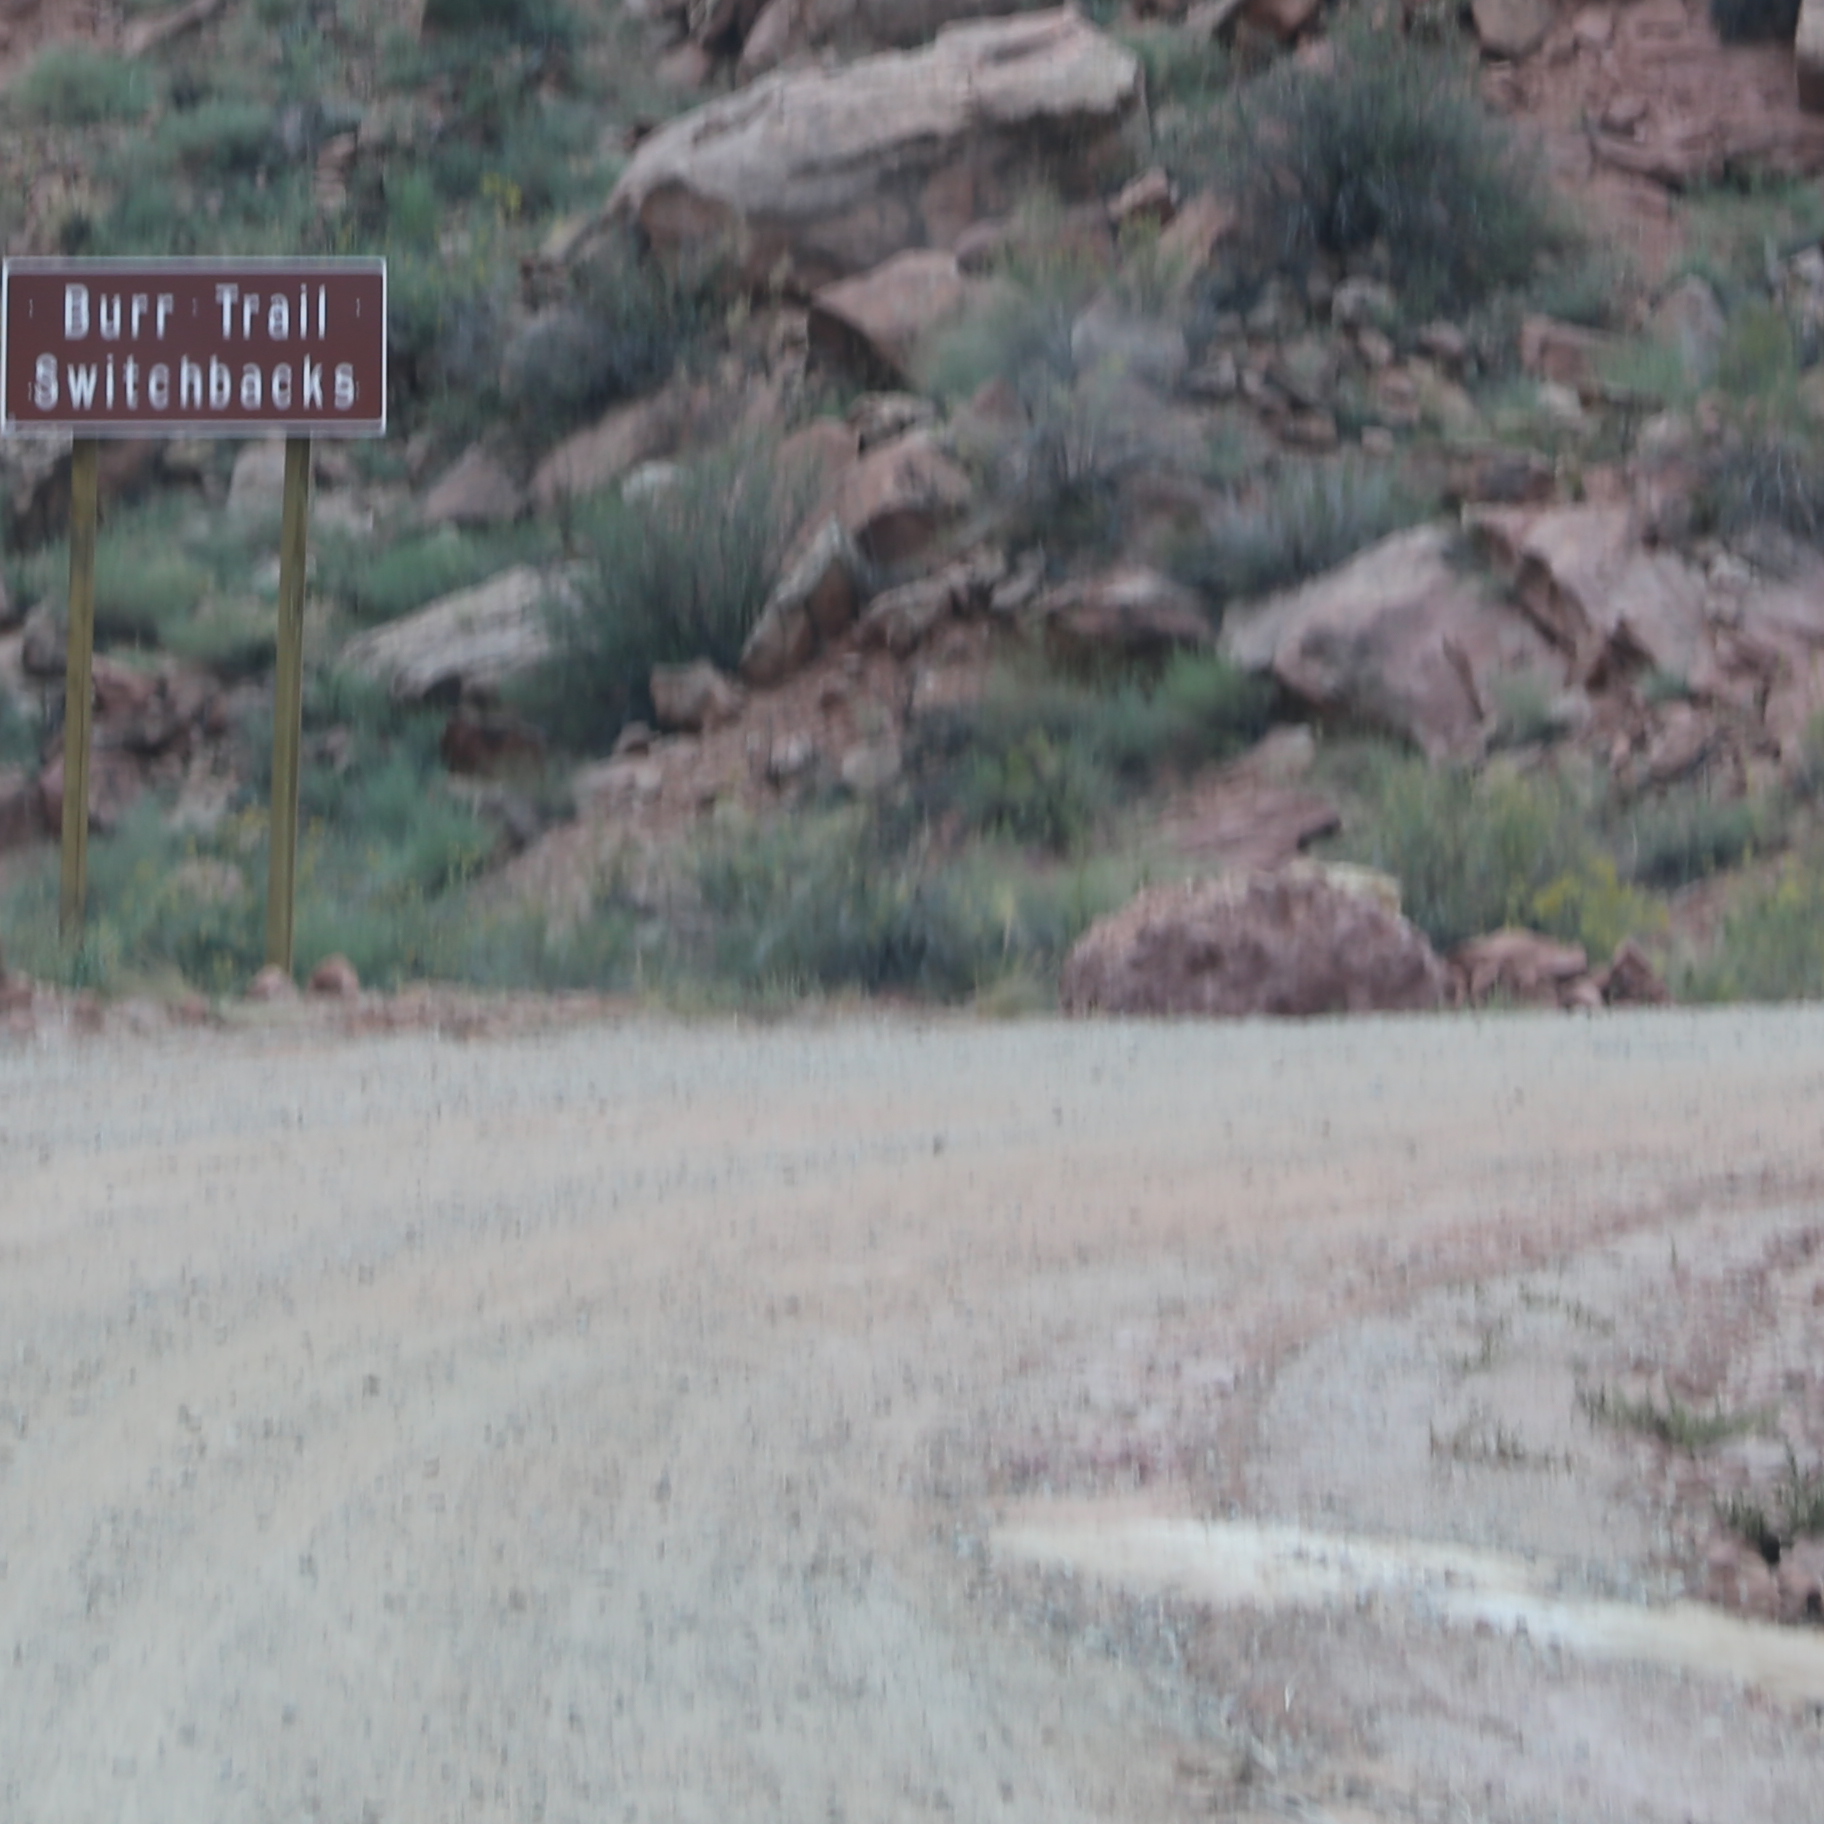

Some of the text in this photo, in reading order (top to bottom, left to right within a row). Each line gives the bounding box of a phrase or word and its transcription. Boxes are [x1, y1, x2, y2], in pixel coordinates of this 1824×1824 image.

[64, 283, 328, 340] Burr Trail
[34, 352, 355, 412] Switchbacks
